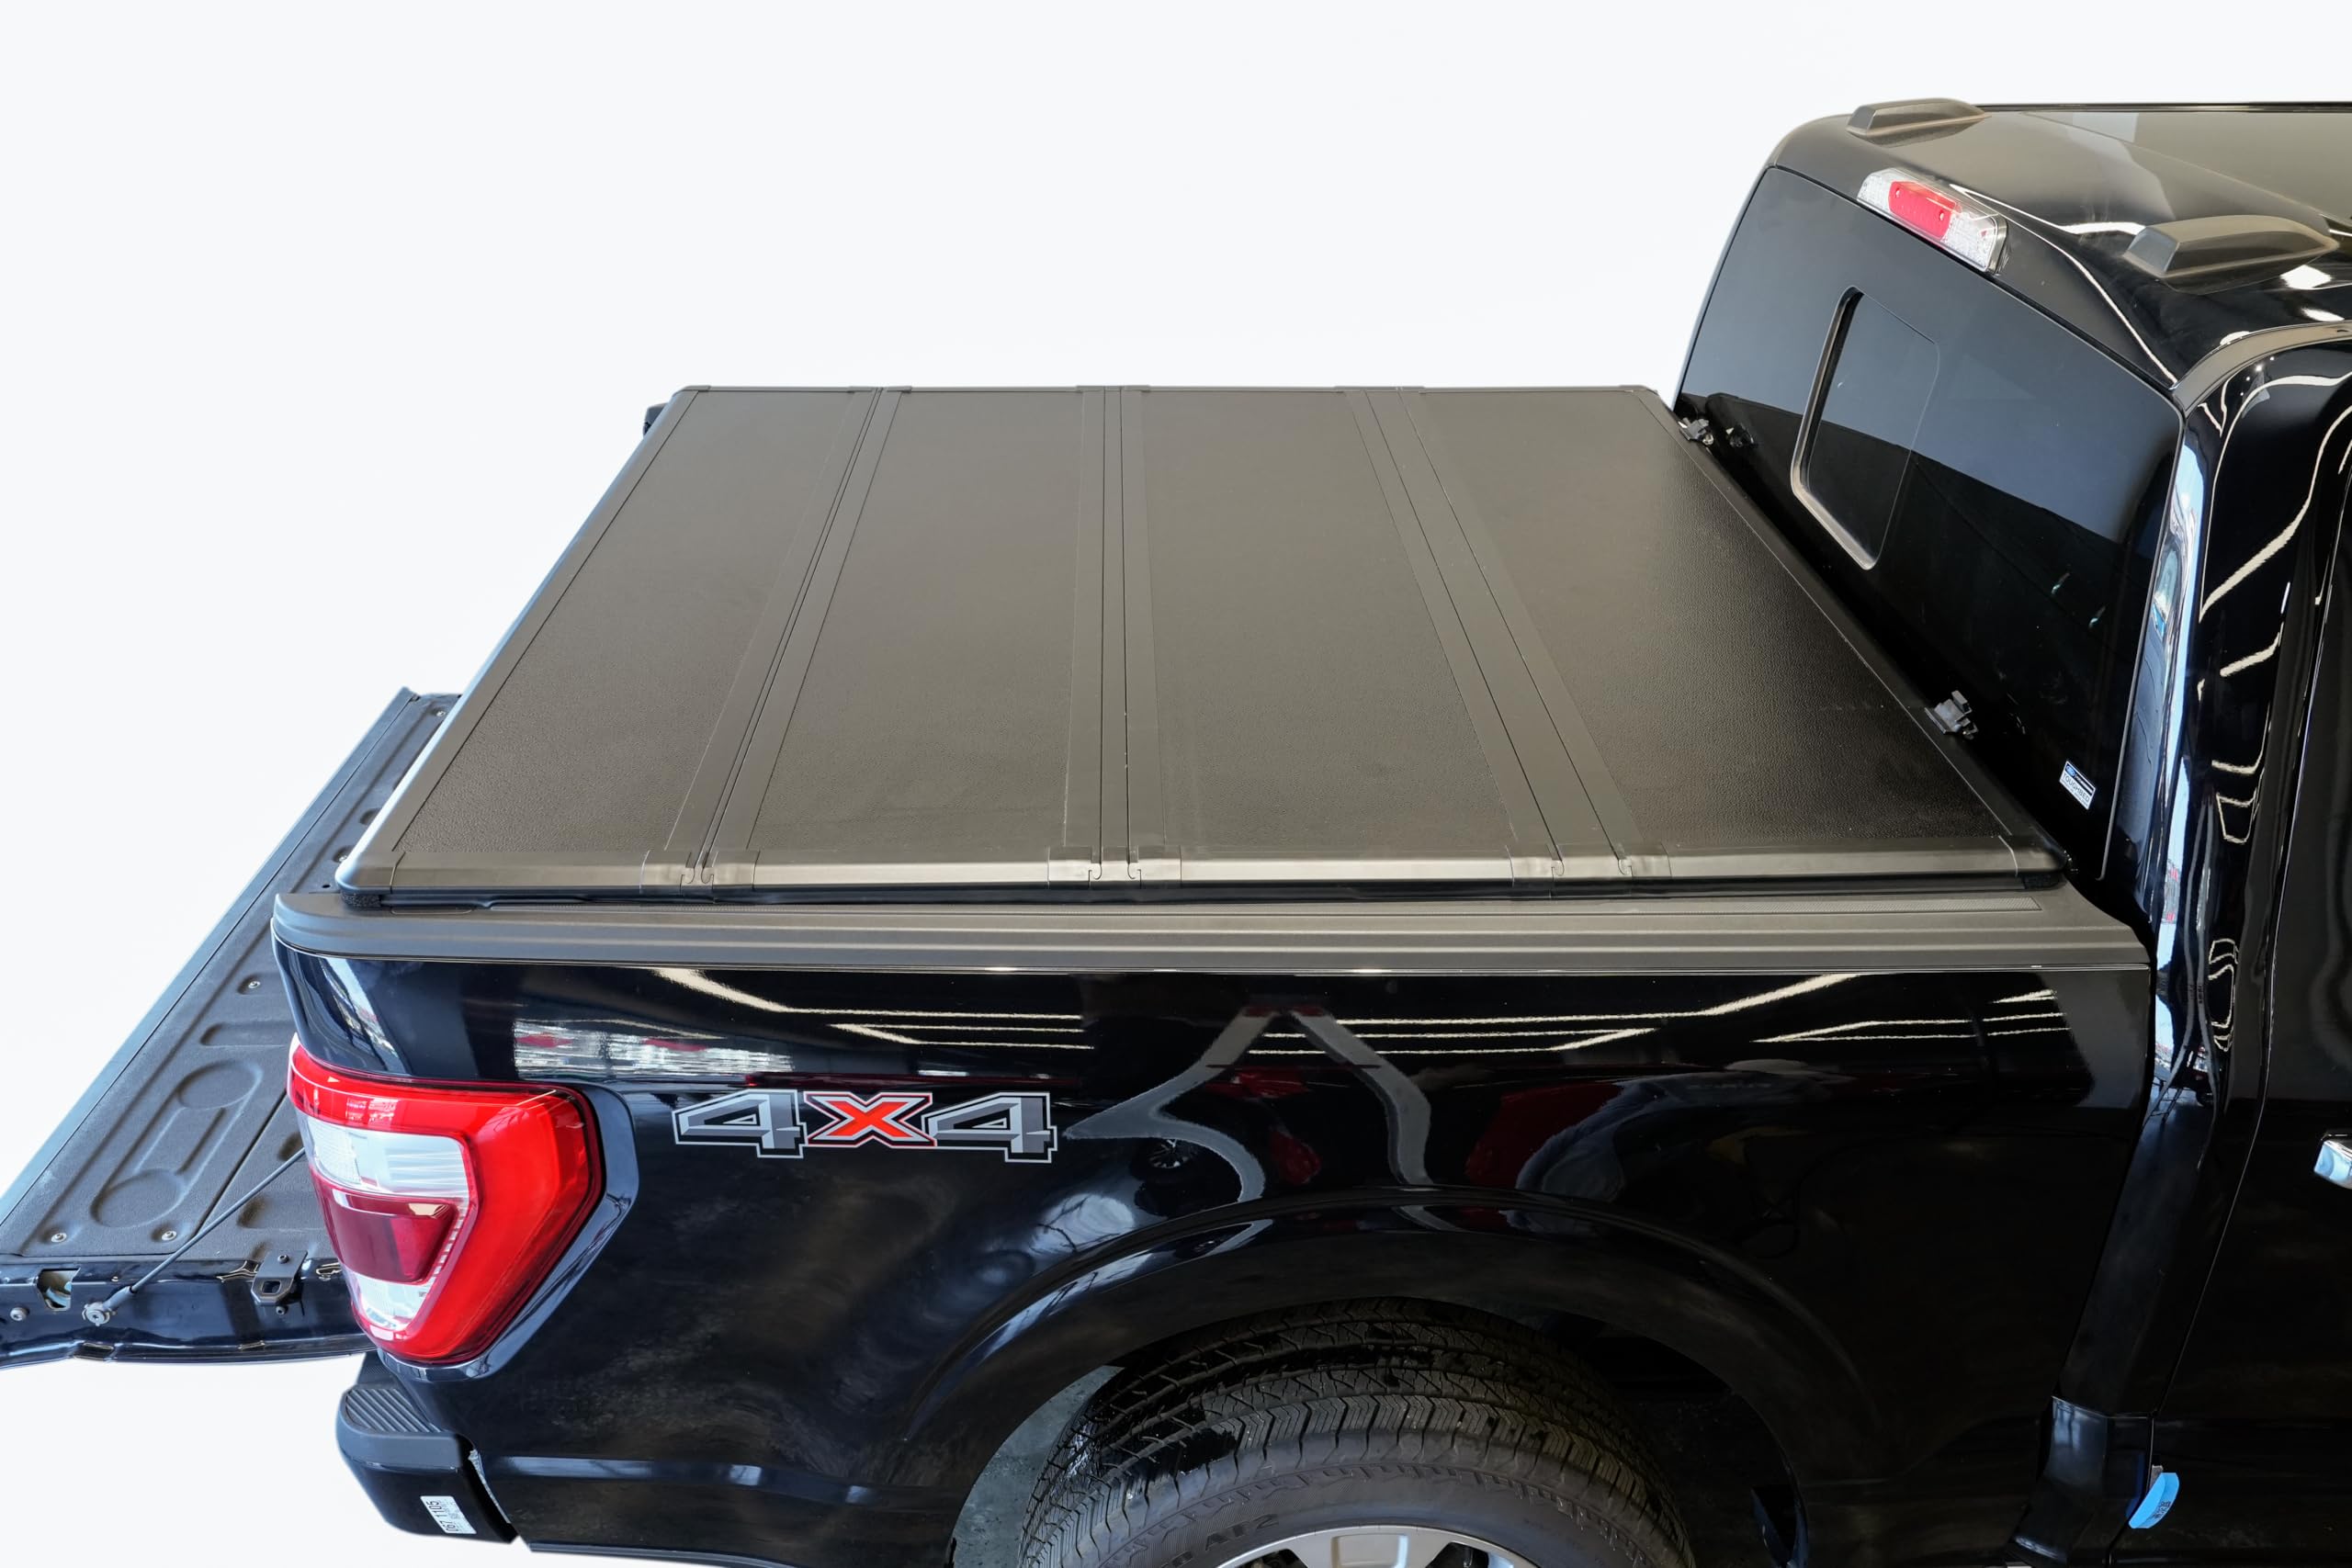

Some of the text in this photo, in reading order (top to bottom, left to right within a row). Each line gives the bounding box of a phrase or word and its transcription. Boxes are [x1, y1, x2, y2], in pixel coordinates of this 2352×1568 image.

[2064, 773, 2090, 803] TOUGHBED
[672, 1089, 1057, 1163] 4X4
[426, 1500, 447, 1517] 1105
